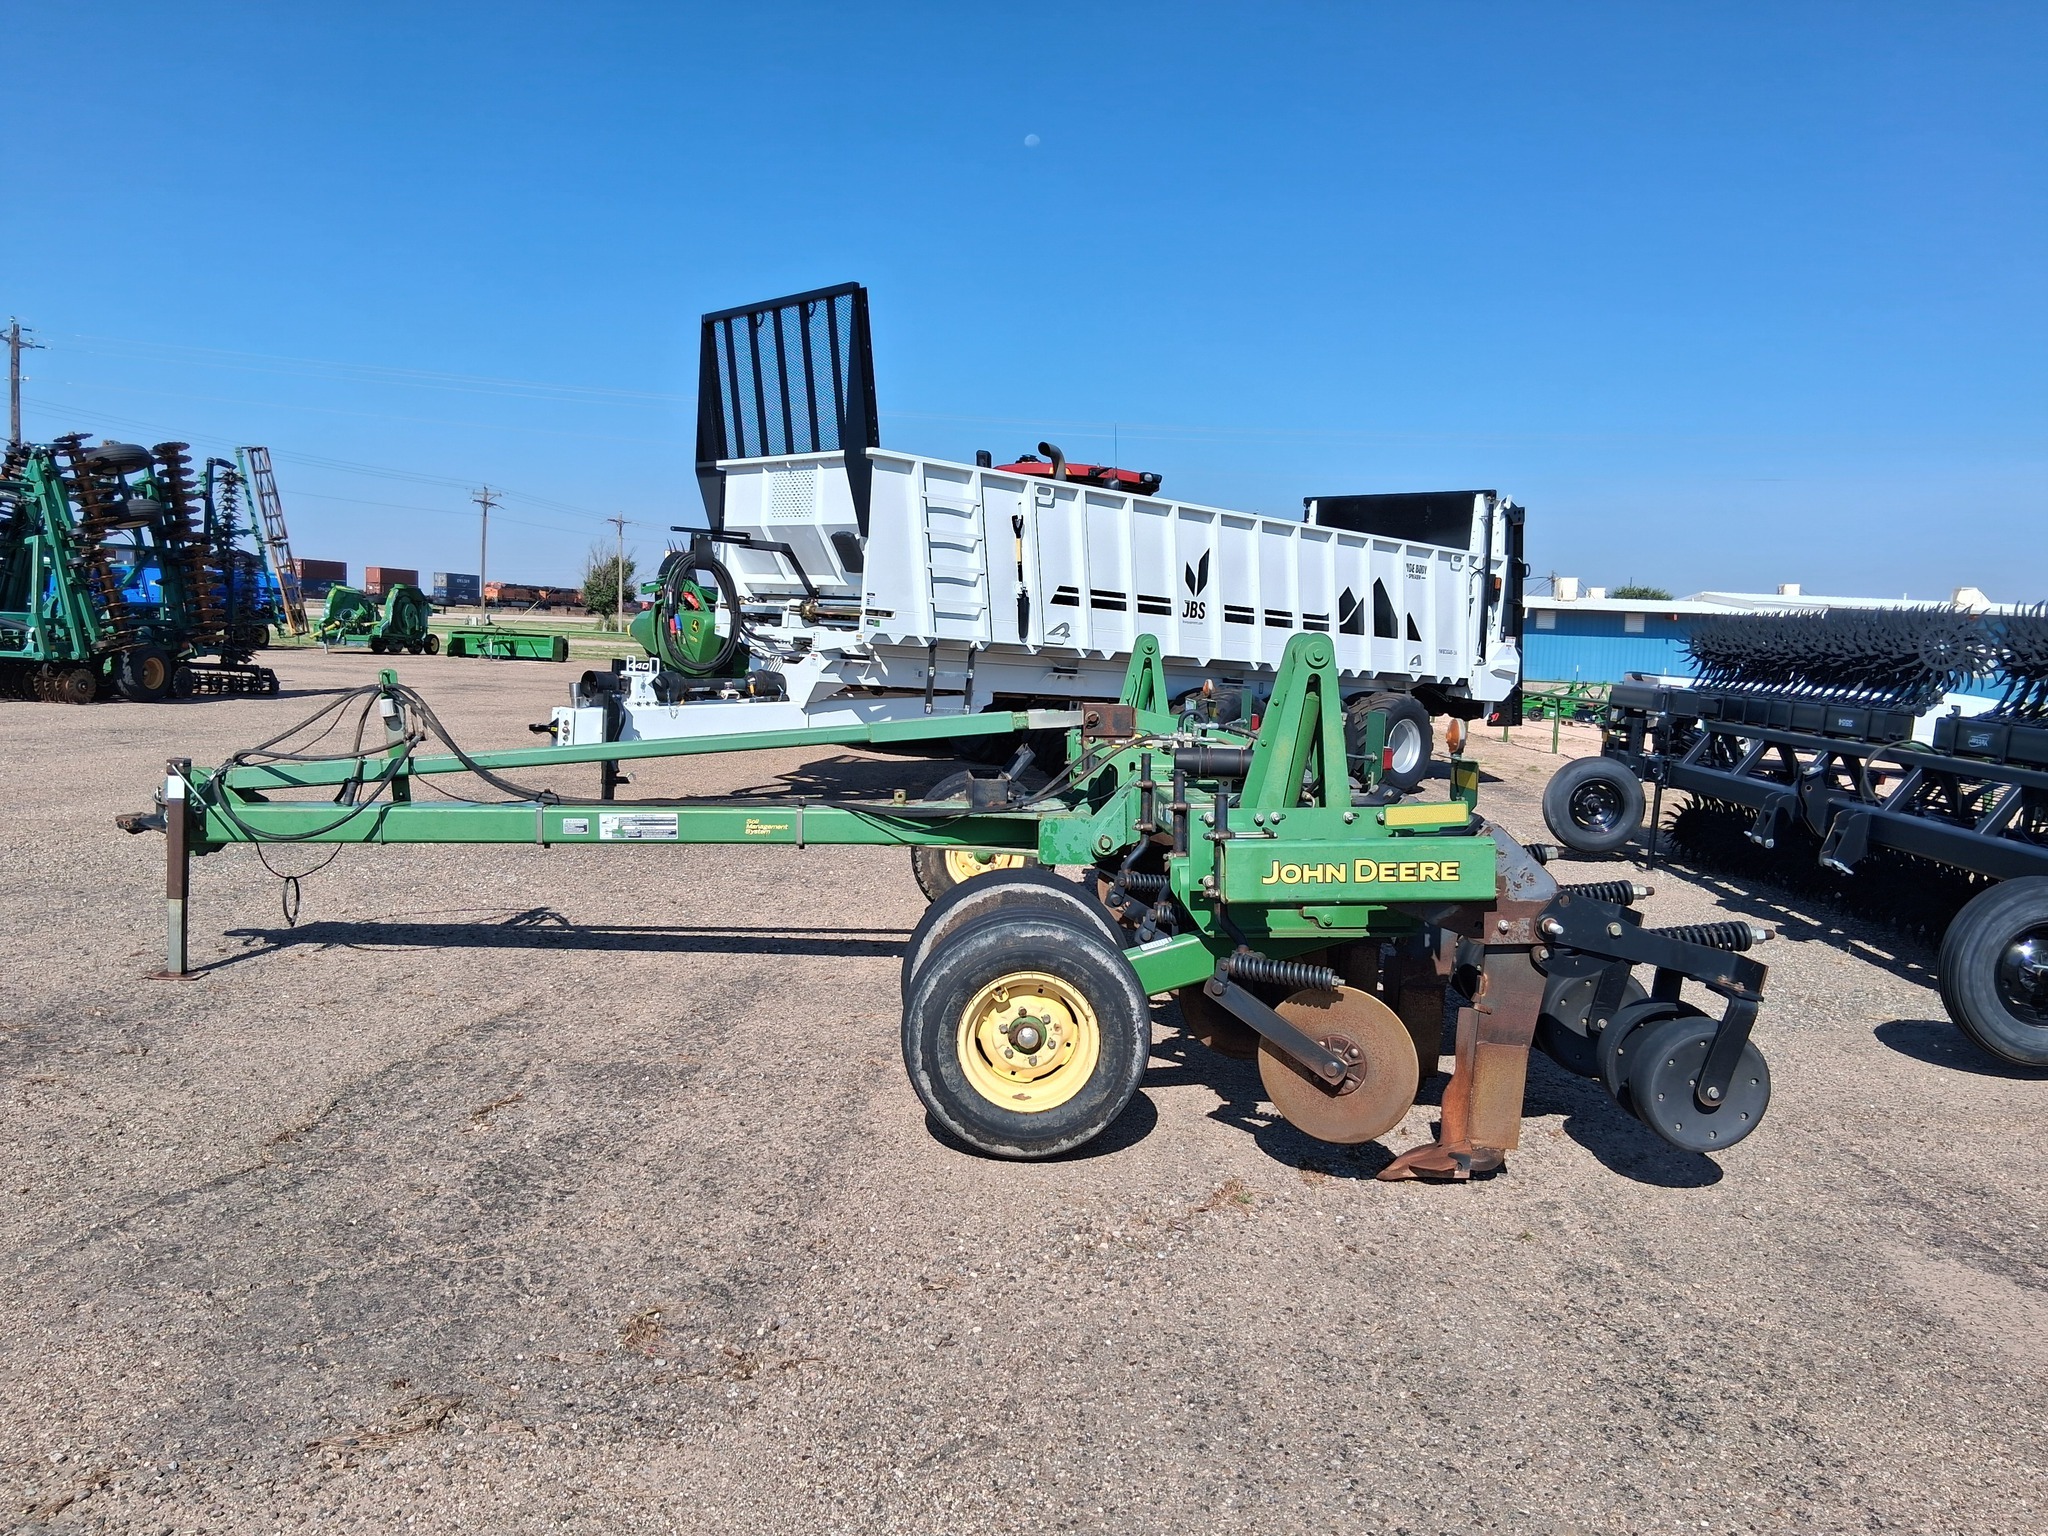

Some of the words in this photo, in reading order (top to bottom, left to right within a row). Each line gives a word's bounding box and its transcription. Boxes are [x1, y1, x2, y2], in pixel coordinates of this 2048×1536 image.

[1182, 600, 1206, 620] JBS
[1261, 860, 1347, 885] JOHN
[1353, 858, 1461, 883] DEERE
